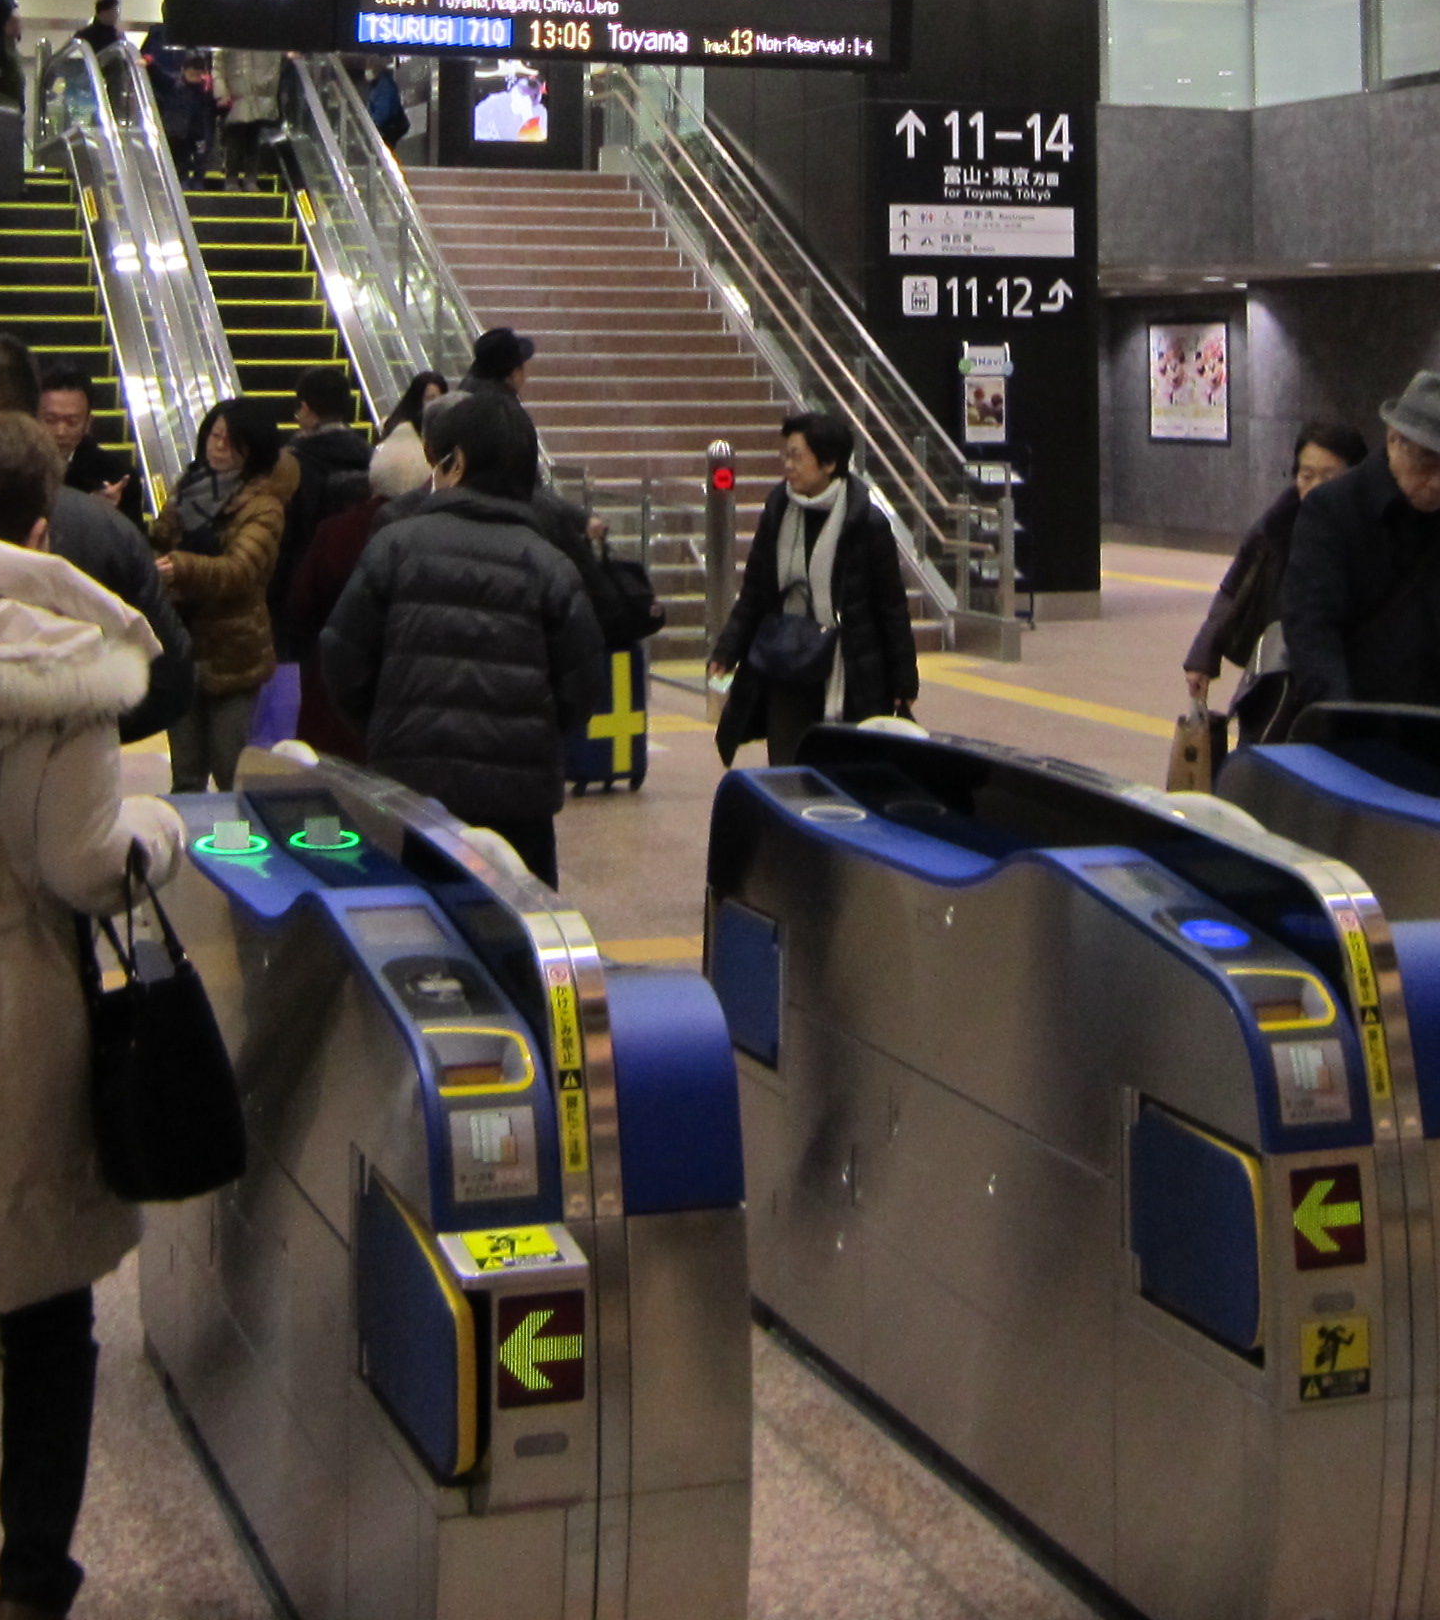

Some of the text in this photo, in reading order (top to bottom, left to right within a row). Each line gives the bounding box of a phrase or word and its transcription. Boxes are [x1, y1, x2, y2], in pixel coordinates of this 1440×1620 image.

[364, 14, 454, 41] TSURUGI
[467, 19, 505, 44] 710
[530, 20, 591, 51] 13:06
[607, 22, 689, 53] Toyama
[703, 38, 730, 55] Track
[730, 28, 753, 56] 13
[944, 187, 961, 199] for
[964, 188, 1012, 202] Toyama,
